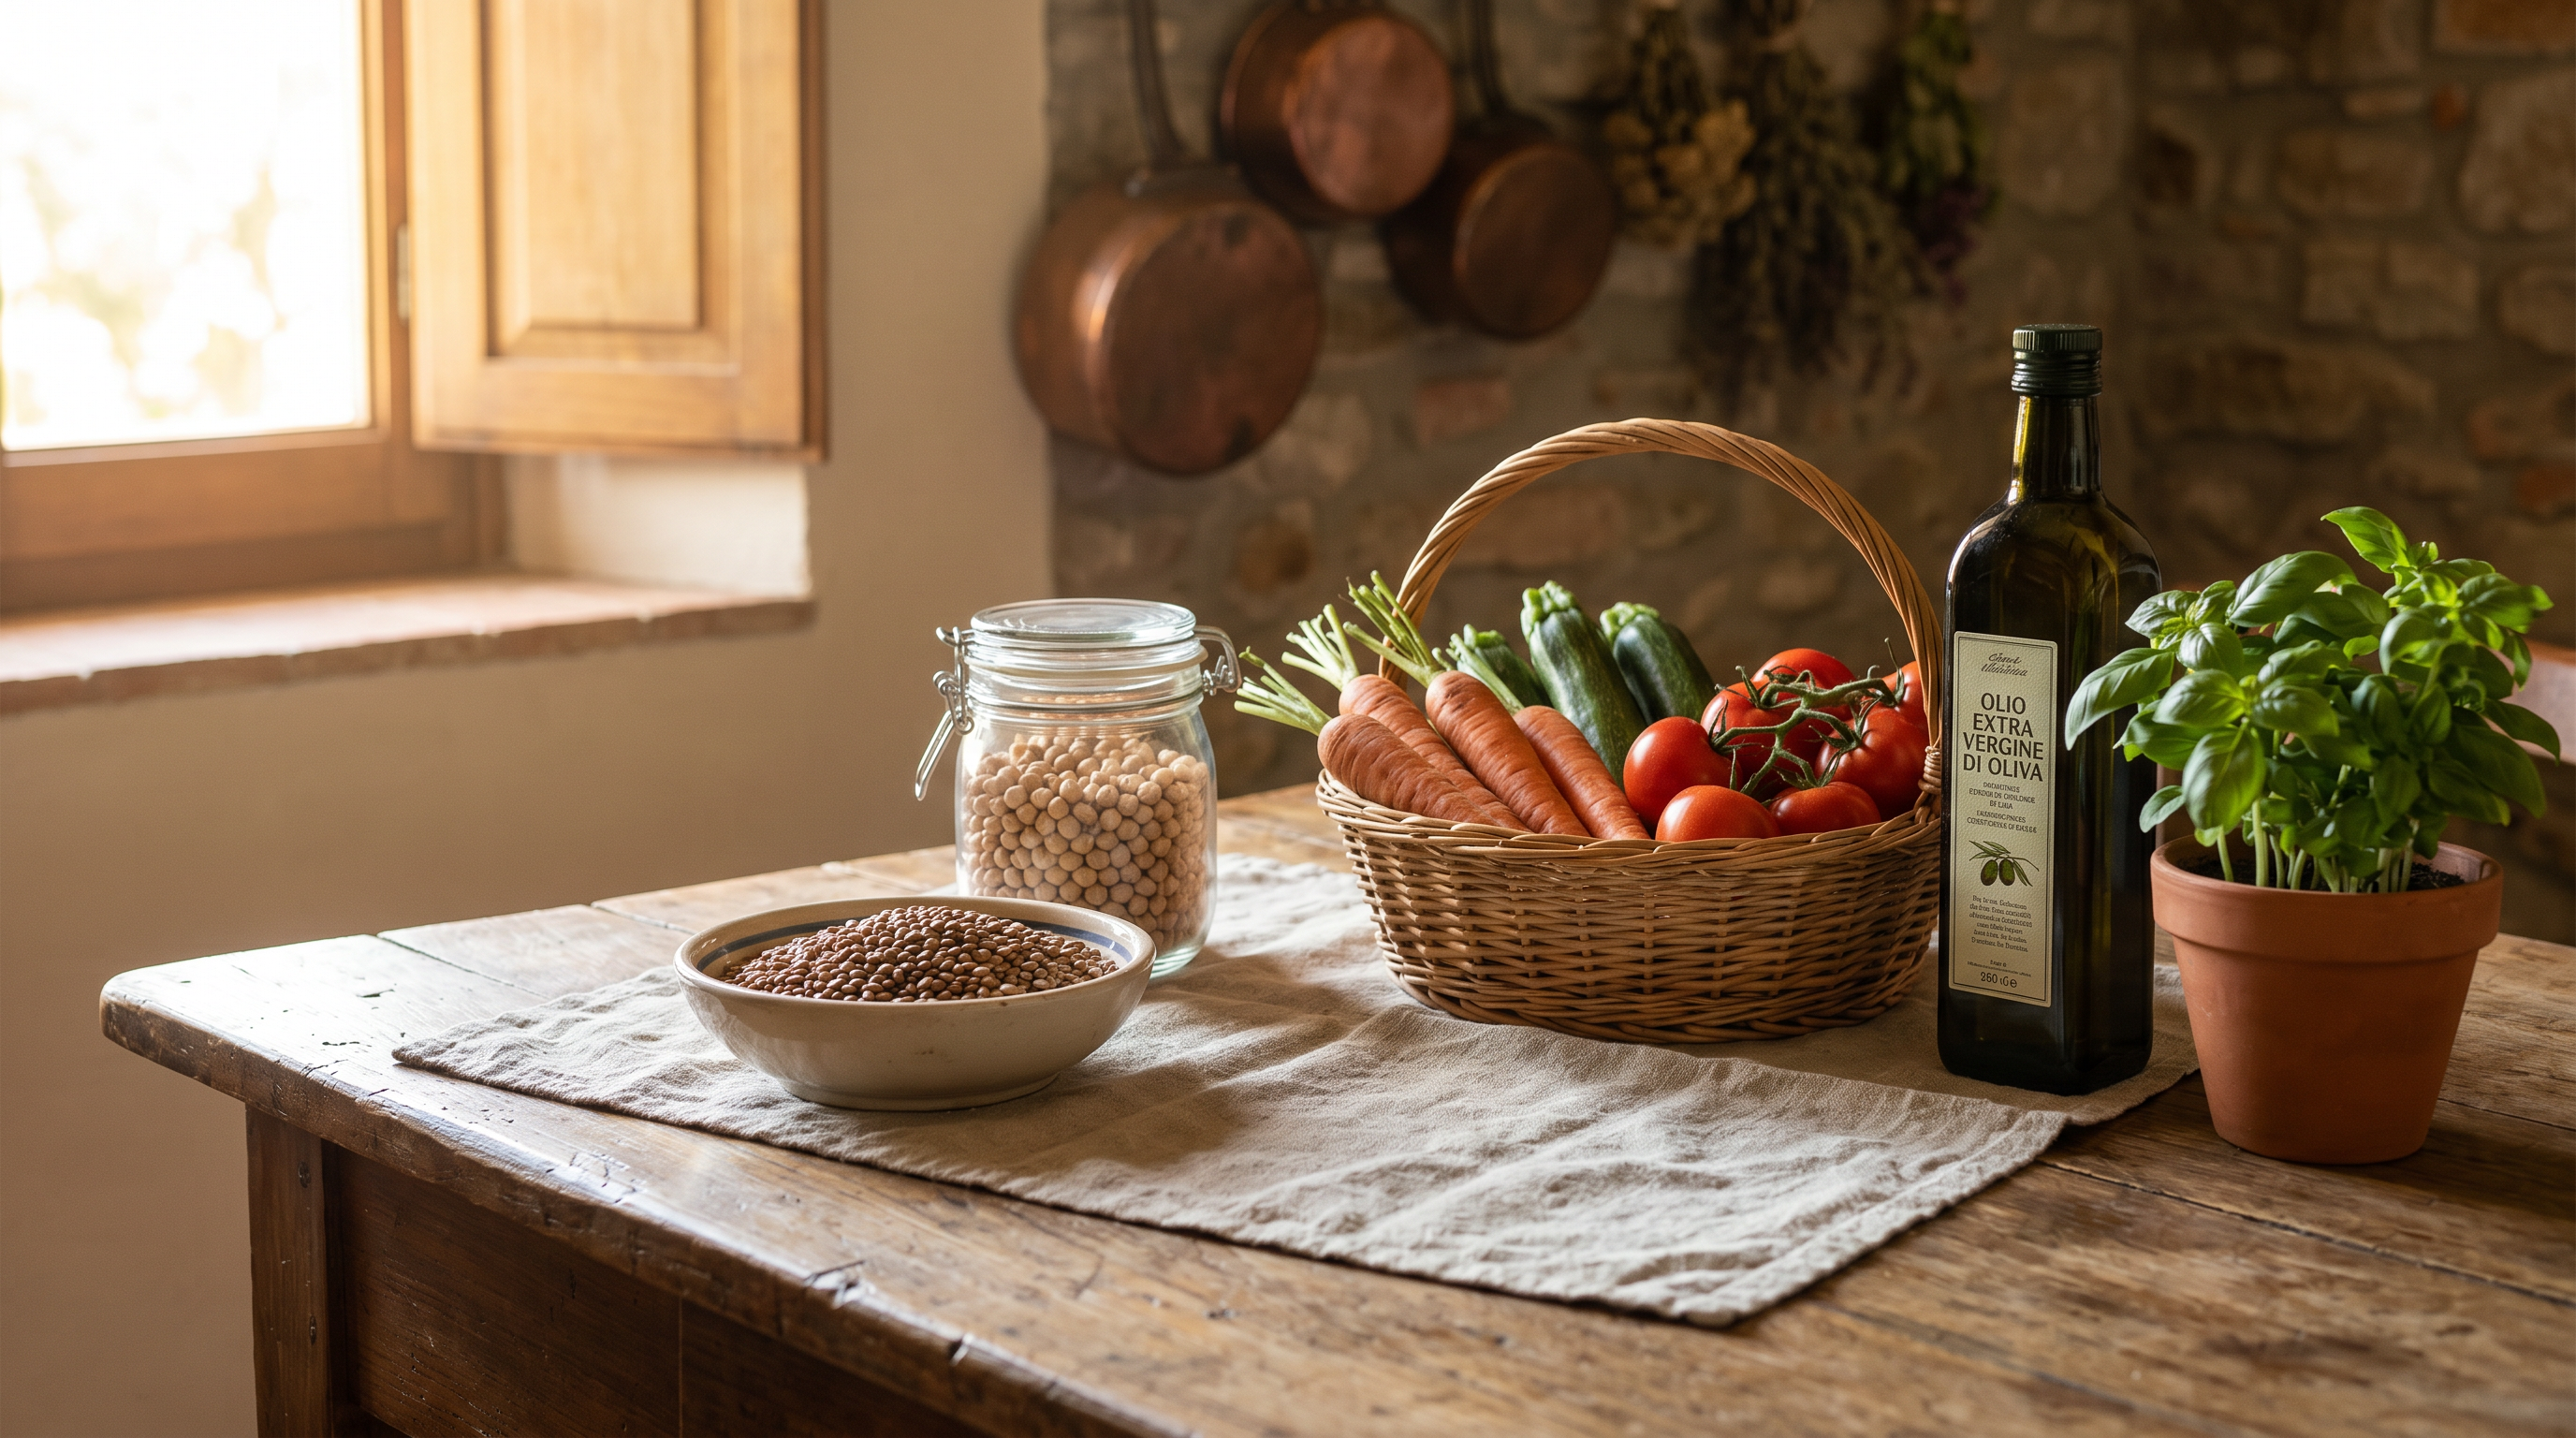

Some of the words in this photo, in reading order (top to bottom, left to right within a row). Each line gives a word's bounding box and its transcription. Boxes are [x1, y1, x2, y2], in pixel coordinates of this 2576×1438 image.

[1981, 692, 2027, 715] OLIO
[1972, 712, 2034, 738] EXTRA
[1962, 731, 2044, 760] VERGINE
[1963, 753, 1982, 773] DI
[1987, 756, 2043, 782] OLIVA
